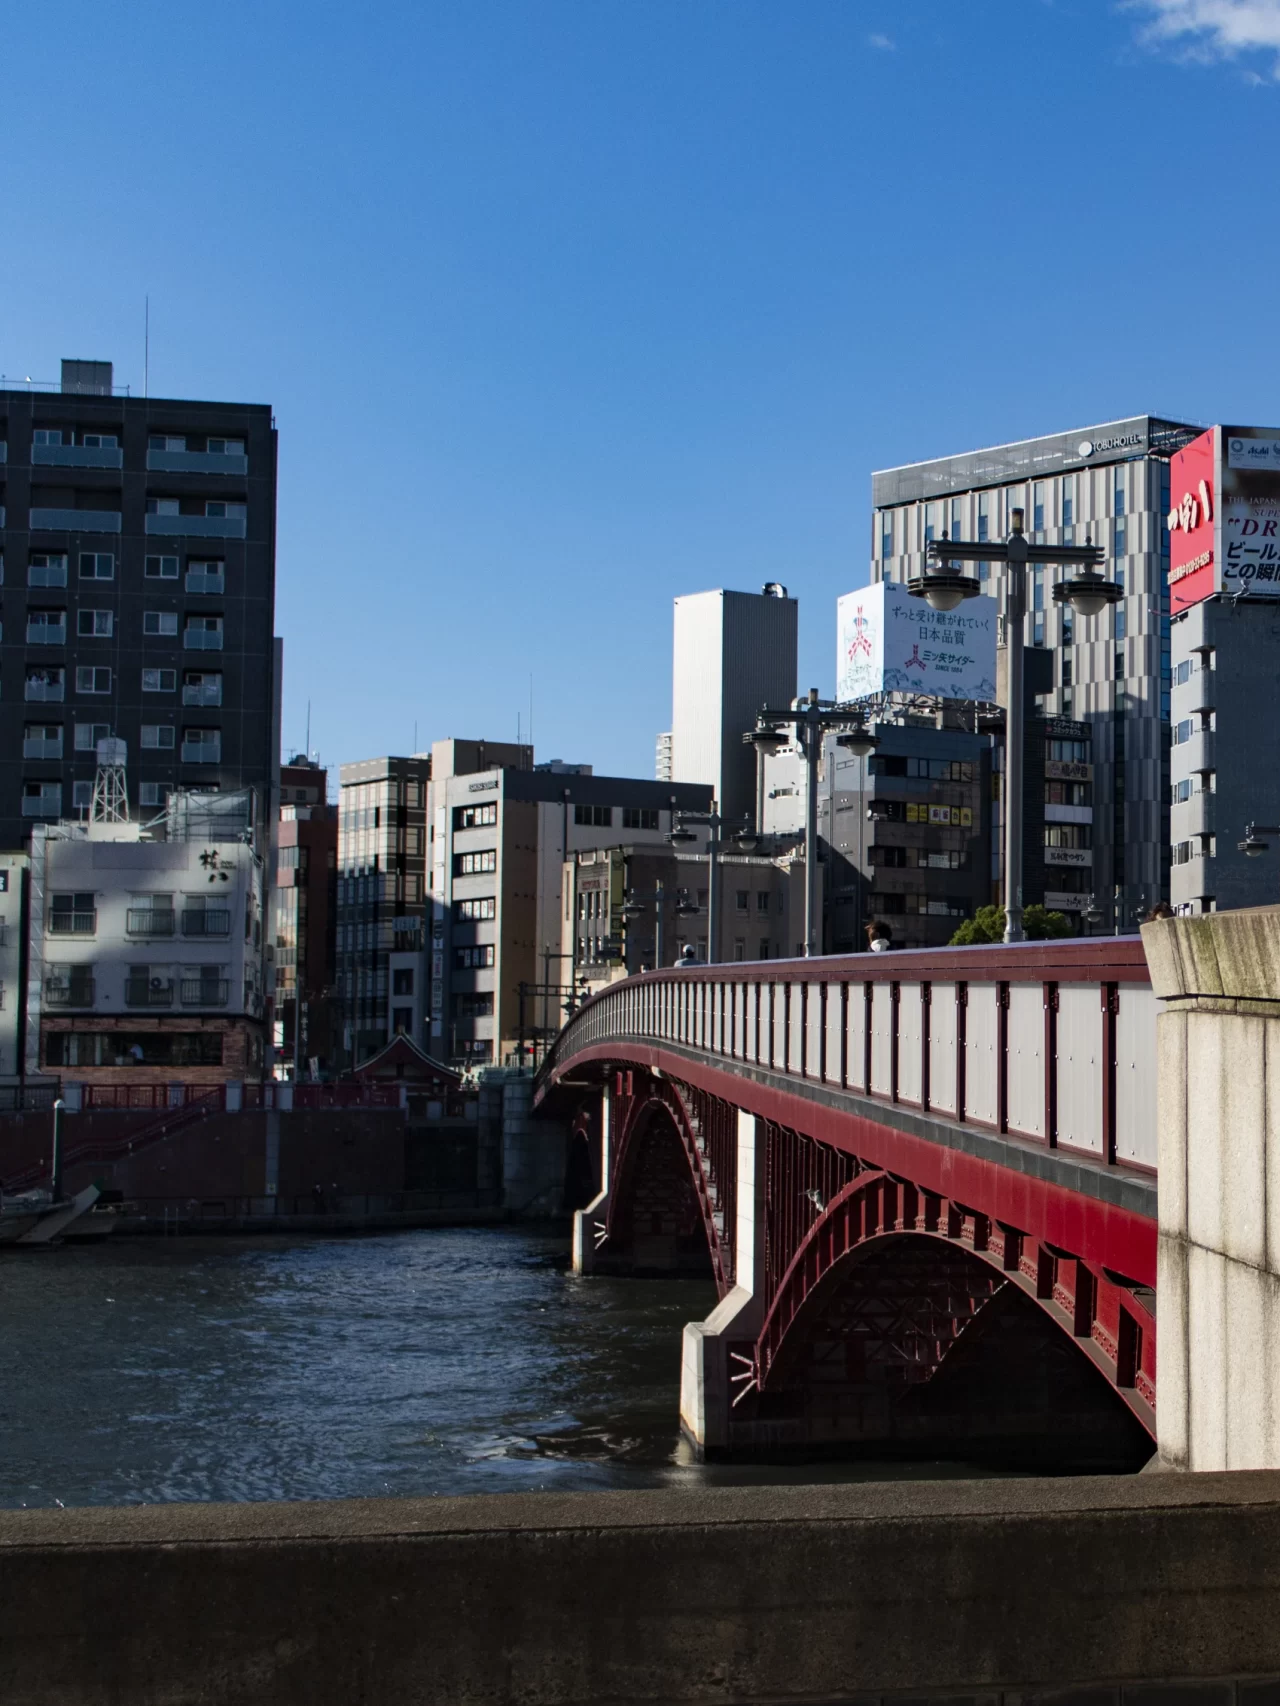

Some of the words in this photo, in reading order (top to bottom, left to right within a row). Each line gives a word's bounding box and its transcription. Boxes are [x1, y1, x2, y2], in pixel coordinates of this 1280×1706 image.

[1093, 440, 1113, 452] TOBU
[1114, 434, 1138, 447] HOTEL
[1248, 445, 1269, 455] Asahi
[1228, 496, 1244, 504] THE
[1249, 497, 1277, 505] JAPAN
[892, 605, 989, 631] ずっと受け継がれていく
[919, 626, 966, 646] 日本品質
[922, 650, 976, 666] 三ツ矢サイダー
[935, 664, 949, 672] SINCE
[1053, 720, 1082, 729] インターネット
[1053, 727, 1082, 736] コミックカフェ
